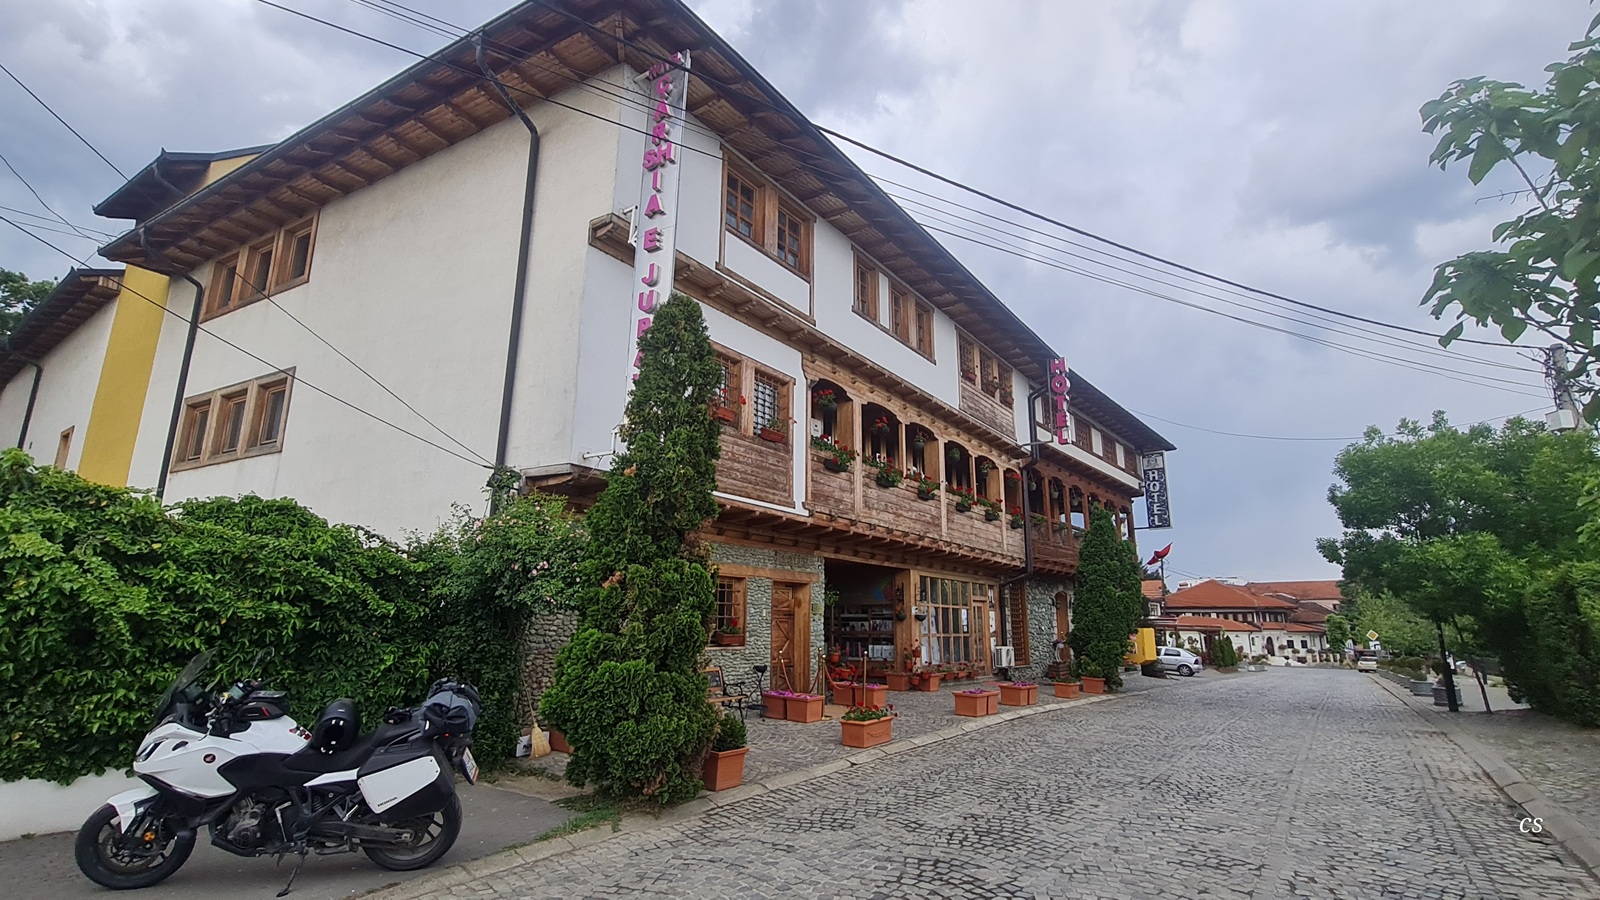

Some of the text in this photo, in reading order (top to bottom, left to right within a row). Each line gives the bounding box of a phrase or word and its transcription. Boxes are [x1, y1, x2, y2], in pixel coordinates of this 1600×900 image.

[643, 227, 663, 252] E
[1050, 357, 1070, 445] HOTEL
[1148, 470, 1163, 526] HOTEL
